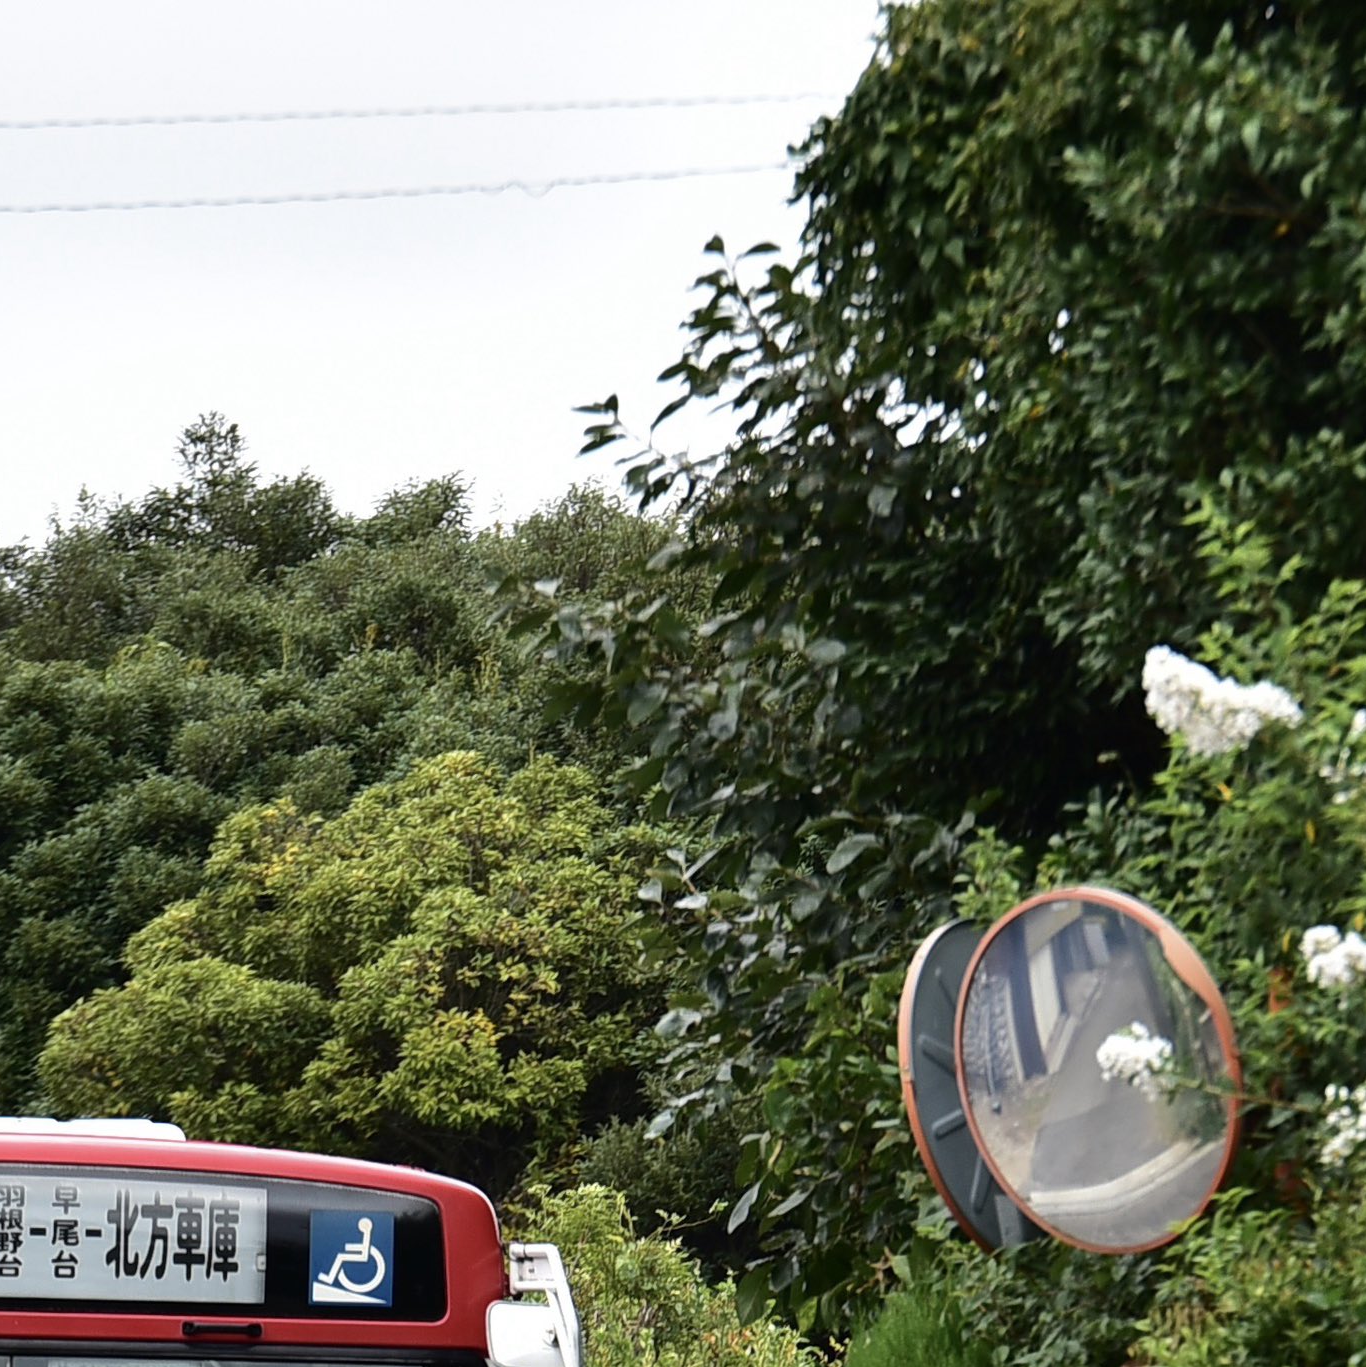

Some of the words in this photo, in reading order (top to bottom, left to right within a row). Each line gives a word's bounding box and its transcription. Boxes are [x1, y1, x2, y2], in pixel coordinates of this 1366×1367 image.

[51, 1186, 79, 1279] 早尾台
[105, 1188, 240, 1282] 北方車庫
